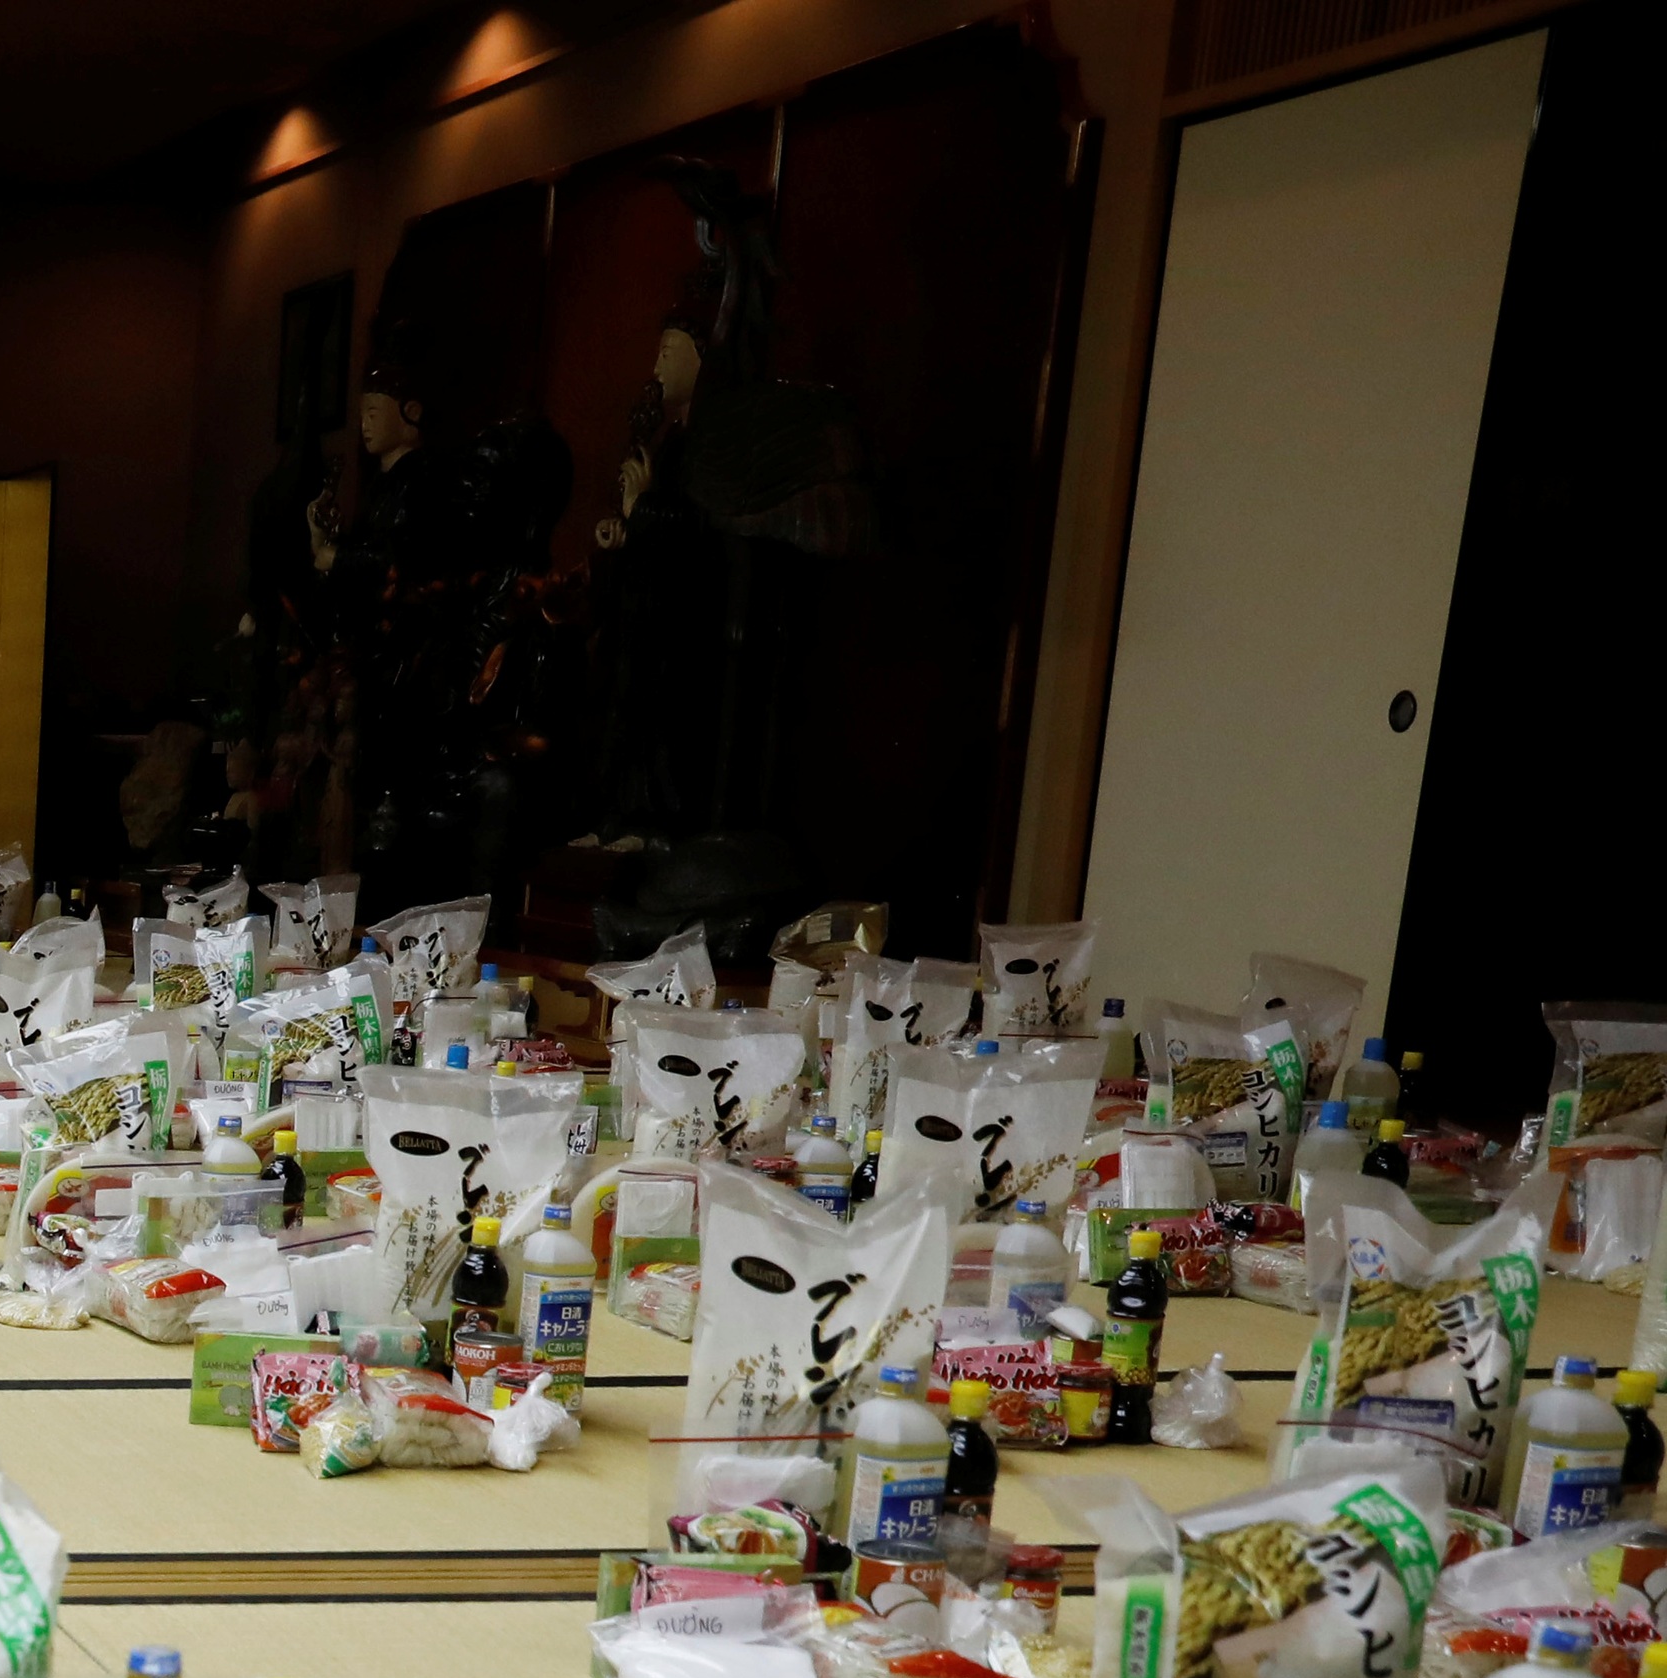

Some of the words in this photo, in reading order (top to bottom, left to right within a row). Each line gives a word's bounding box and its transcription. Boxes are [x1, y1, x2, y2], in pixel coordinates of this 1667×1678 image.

[1241, 1069, 1282, 1200] コシヒカリ
[561, 1306, 582, 1320] 日清
[263, 1369, 313, 1397] Hảo
[909, 1498, 936, 1519] 日清
